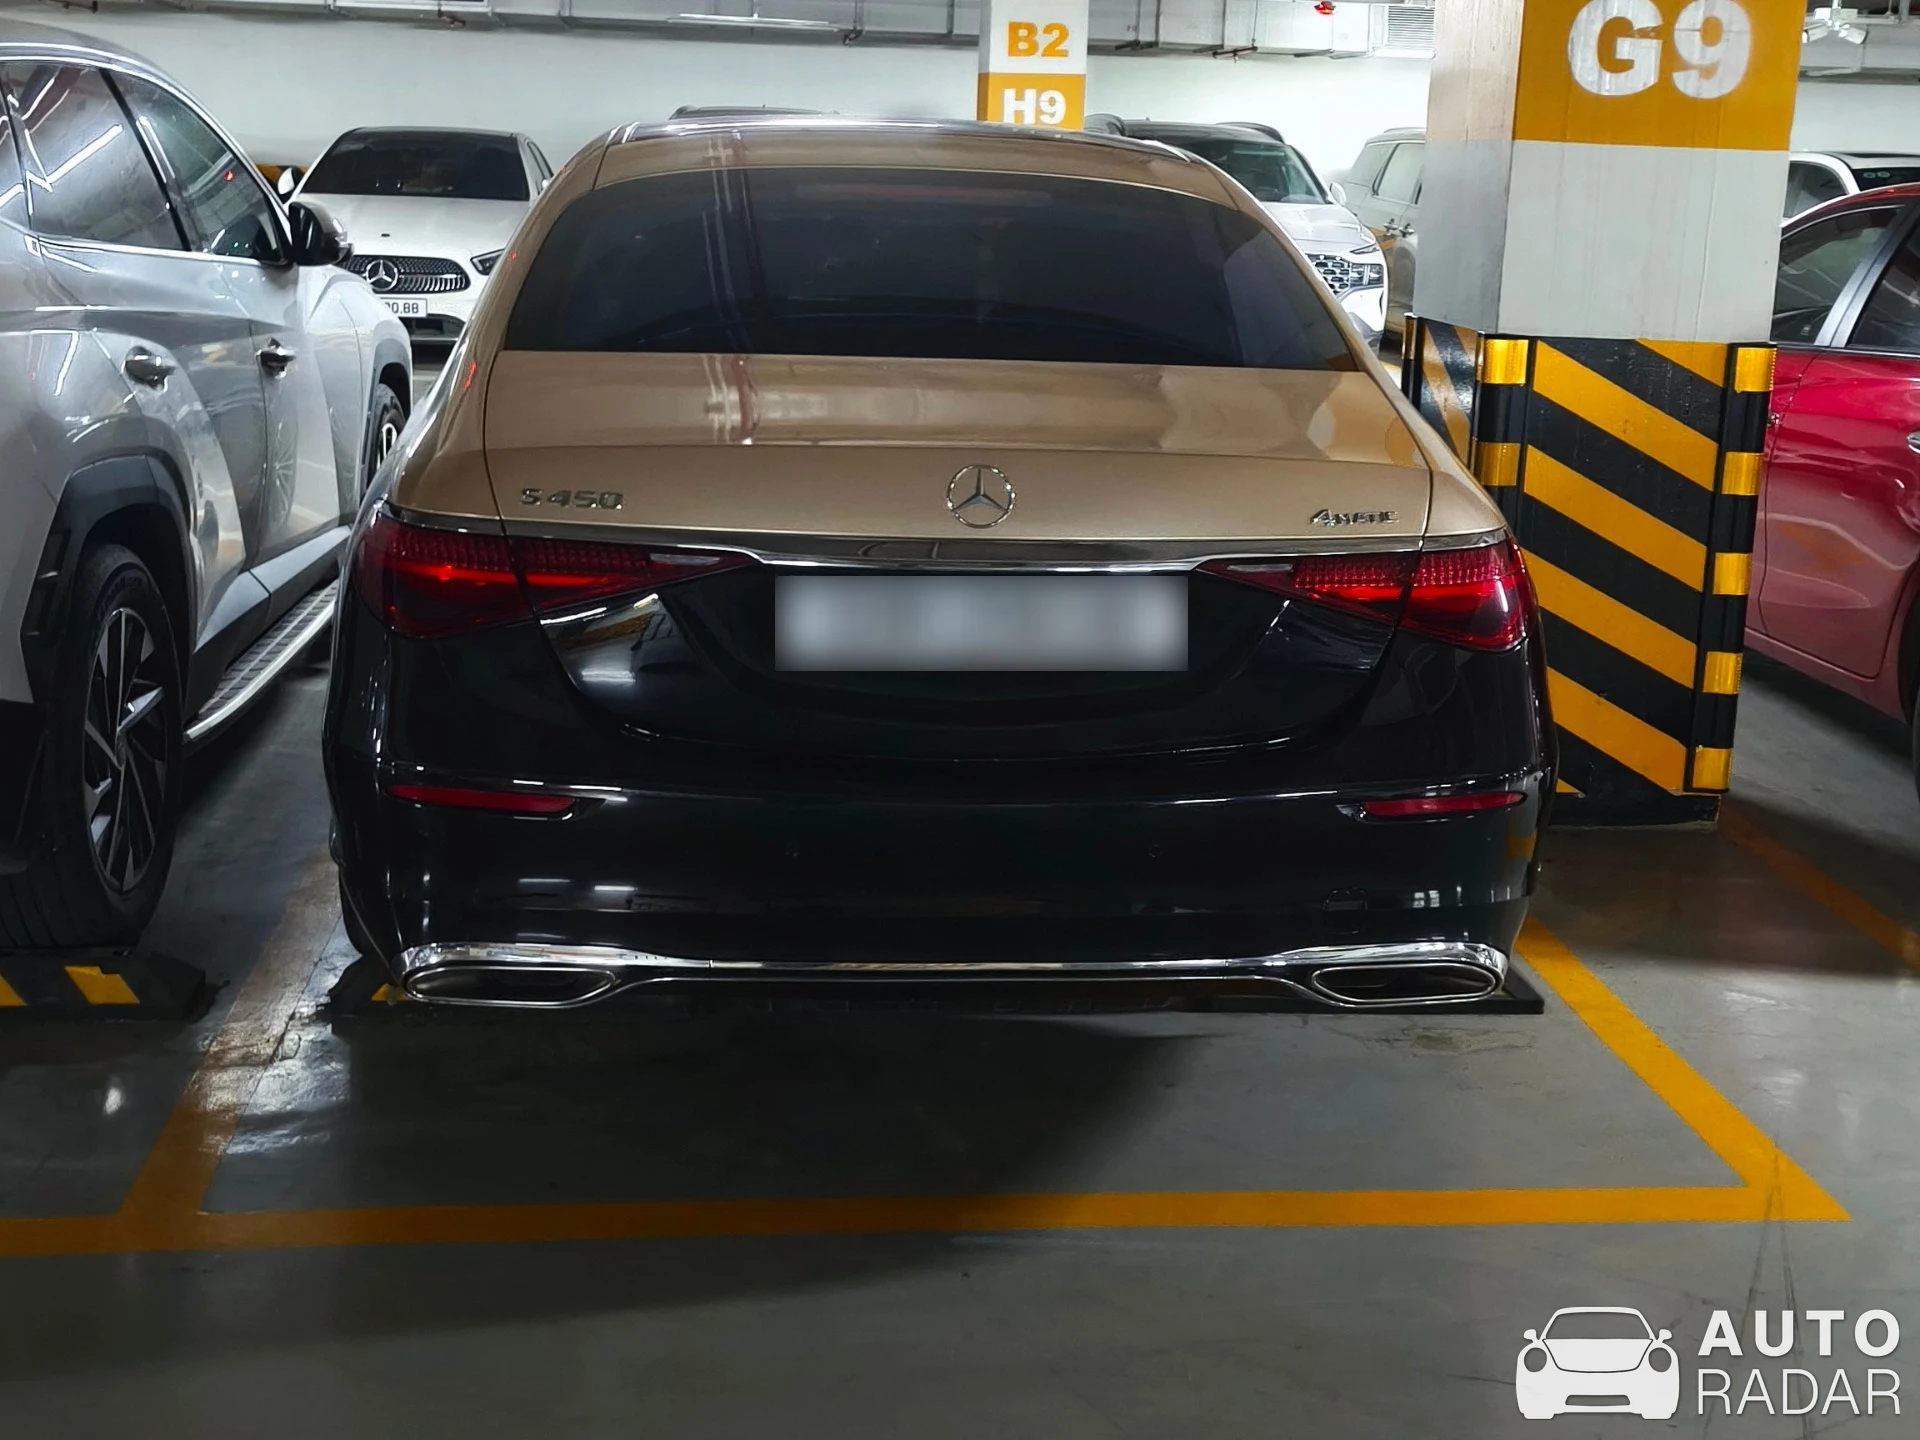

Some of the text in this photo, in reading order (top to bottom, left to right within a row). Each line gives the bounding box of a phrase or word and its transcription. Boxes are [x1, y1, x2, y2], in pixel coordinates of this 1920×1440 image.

[1007, 21, 1069, 57] B2
[1568, 0, 1750, 99] G9
[1003, 88, 1067, 125] H9
[521, 488, 624, 510] S 450
